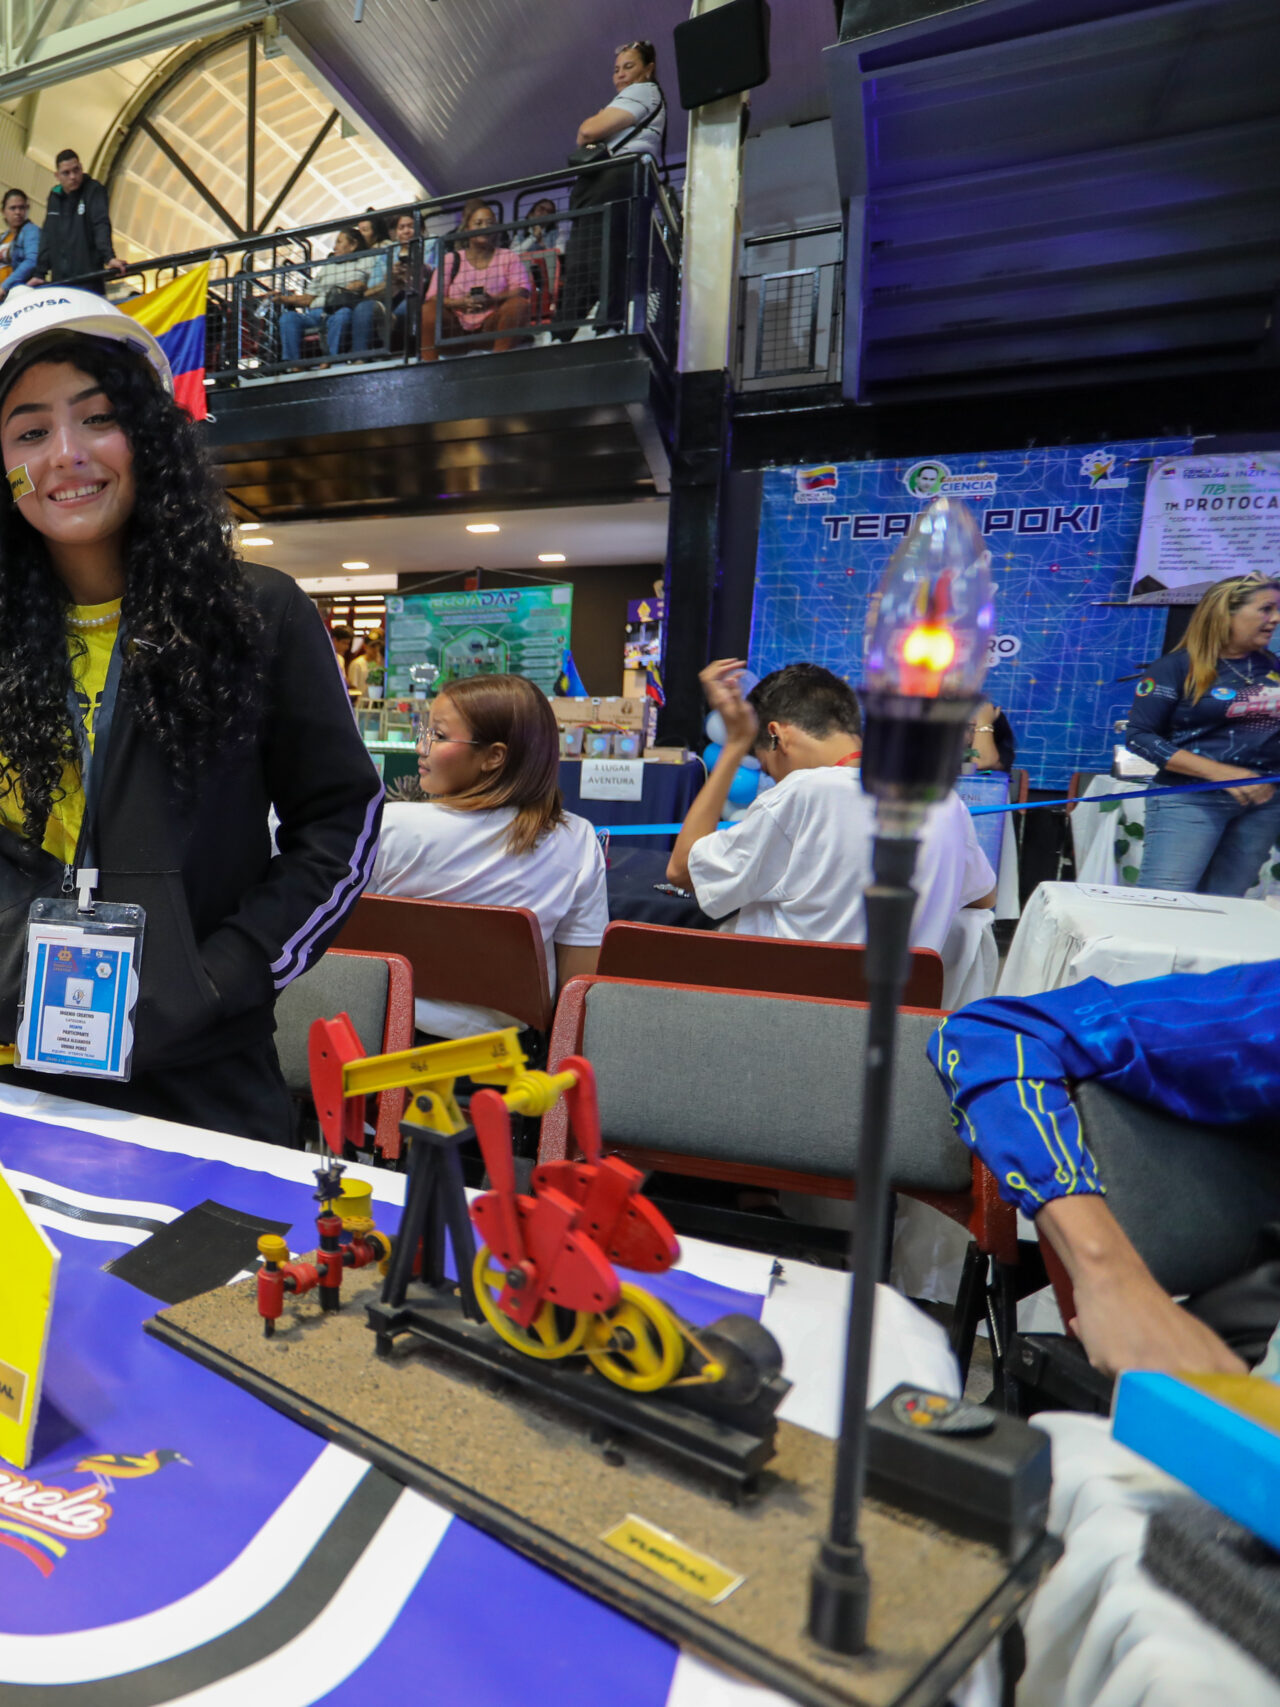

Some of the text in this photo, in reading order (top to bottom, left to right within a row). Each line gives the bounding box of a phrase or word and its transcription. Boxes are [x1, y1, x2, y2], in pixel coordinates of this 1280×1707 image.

[13, 298, 71, 318] PDVSA
[941, 481, 994, 492] CIENCIA
[983, 505, 1102, 537] POKI
[601, 764, 630, 772] LUGAR
[587, 777, 635, 785] AVENTURA
